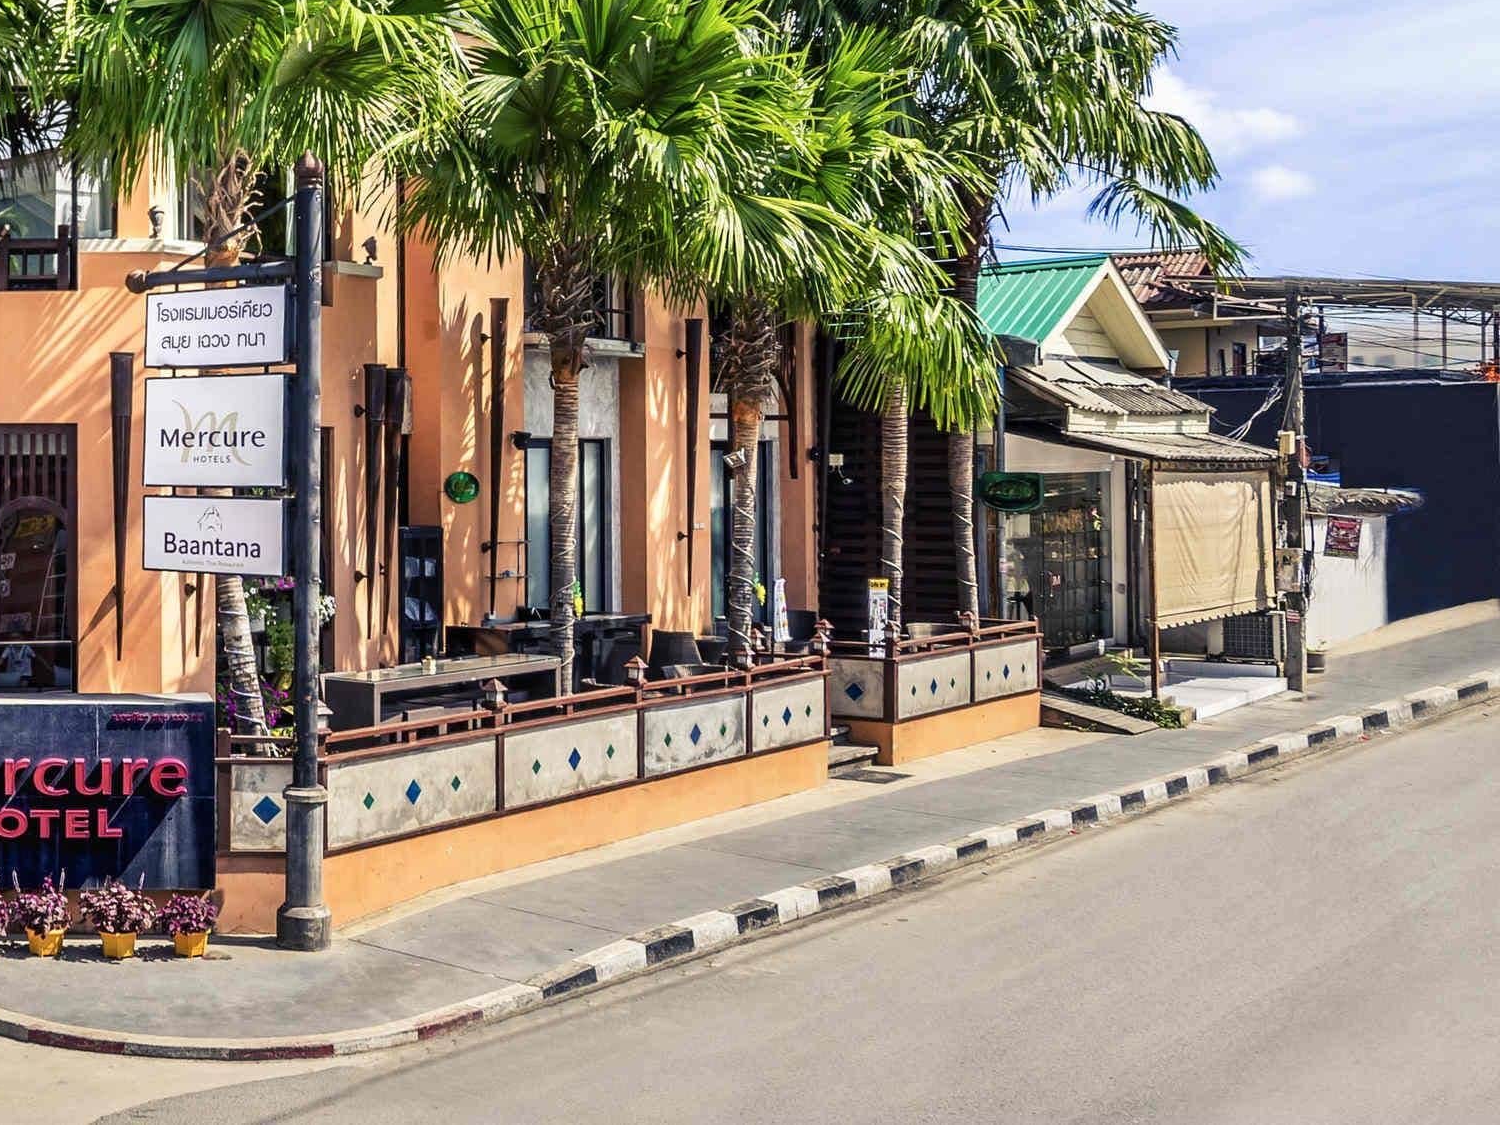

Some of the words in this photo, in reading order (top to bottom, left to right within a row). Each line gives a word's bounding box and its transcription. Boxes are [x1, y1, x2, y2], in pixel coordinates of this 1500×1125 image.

[156, 300, 273, 323] โรงแรมเมอร์เคียว
[161, 334, 191, 354] สมุย
[197, 333, 231, 349] เฉวง
[237, 332, 266, 347] ทนา
[160, 428, 266, 448] Mercure
[192, 455, 231, 464] HOTELS
[164, 532, 261, 558] Baantana
